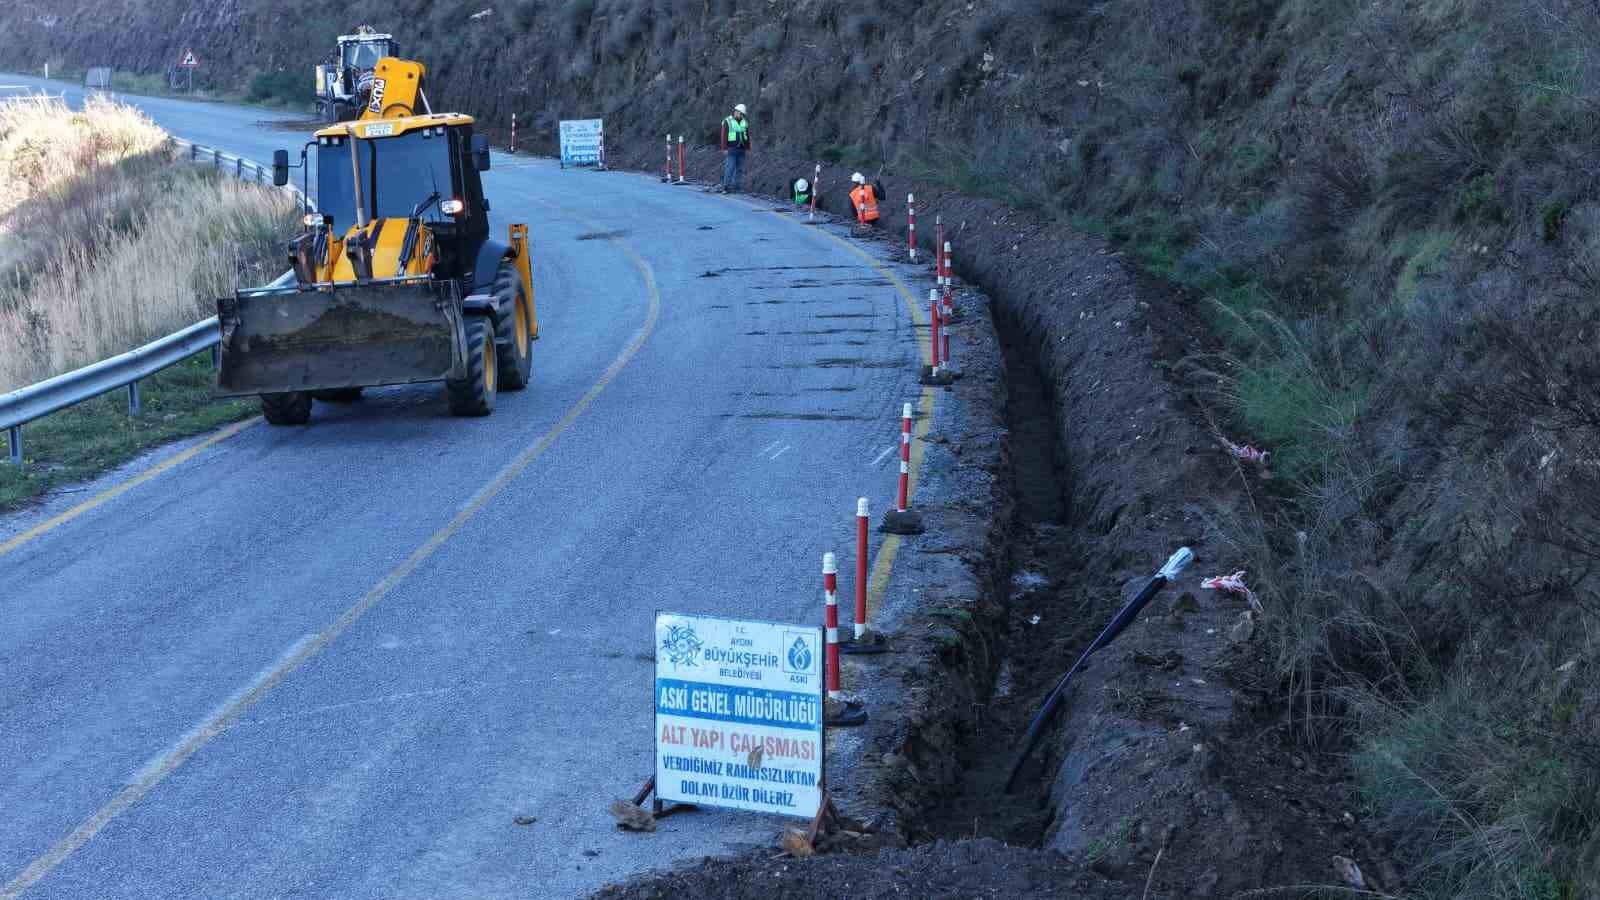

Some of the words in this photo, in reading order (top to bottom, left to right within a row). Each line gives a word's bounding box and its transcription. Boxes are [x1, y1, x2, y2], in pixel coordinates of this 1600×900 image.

[730, 638, 753, 647] AYDIN
[704, 646, 778, 669] BÜYÜKŞEHİR
[719, 667, 762, 681] BELEDİYESİ
[660, 684, 688, 709] ASKİ
[691, 691, 731, 714] GENEL
[734, 692, 816, 724] MÜDÜRLÜĞÜ
[661, 725, 687, 745] ALT
[690, 728, 724, 750] YAPI
[730, 732, 815, 760] ÇALIŞMASI
[662, 753, 723, 776] VERDİĞİMİZ
[681, 779, 718, 798] DOLAYI
[721, 782, 750, 801] ÖZÜR
